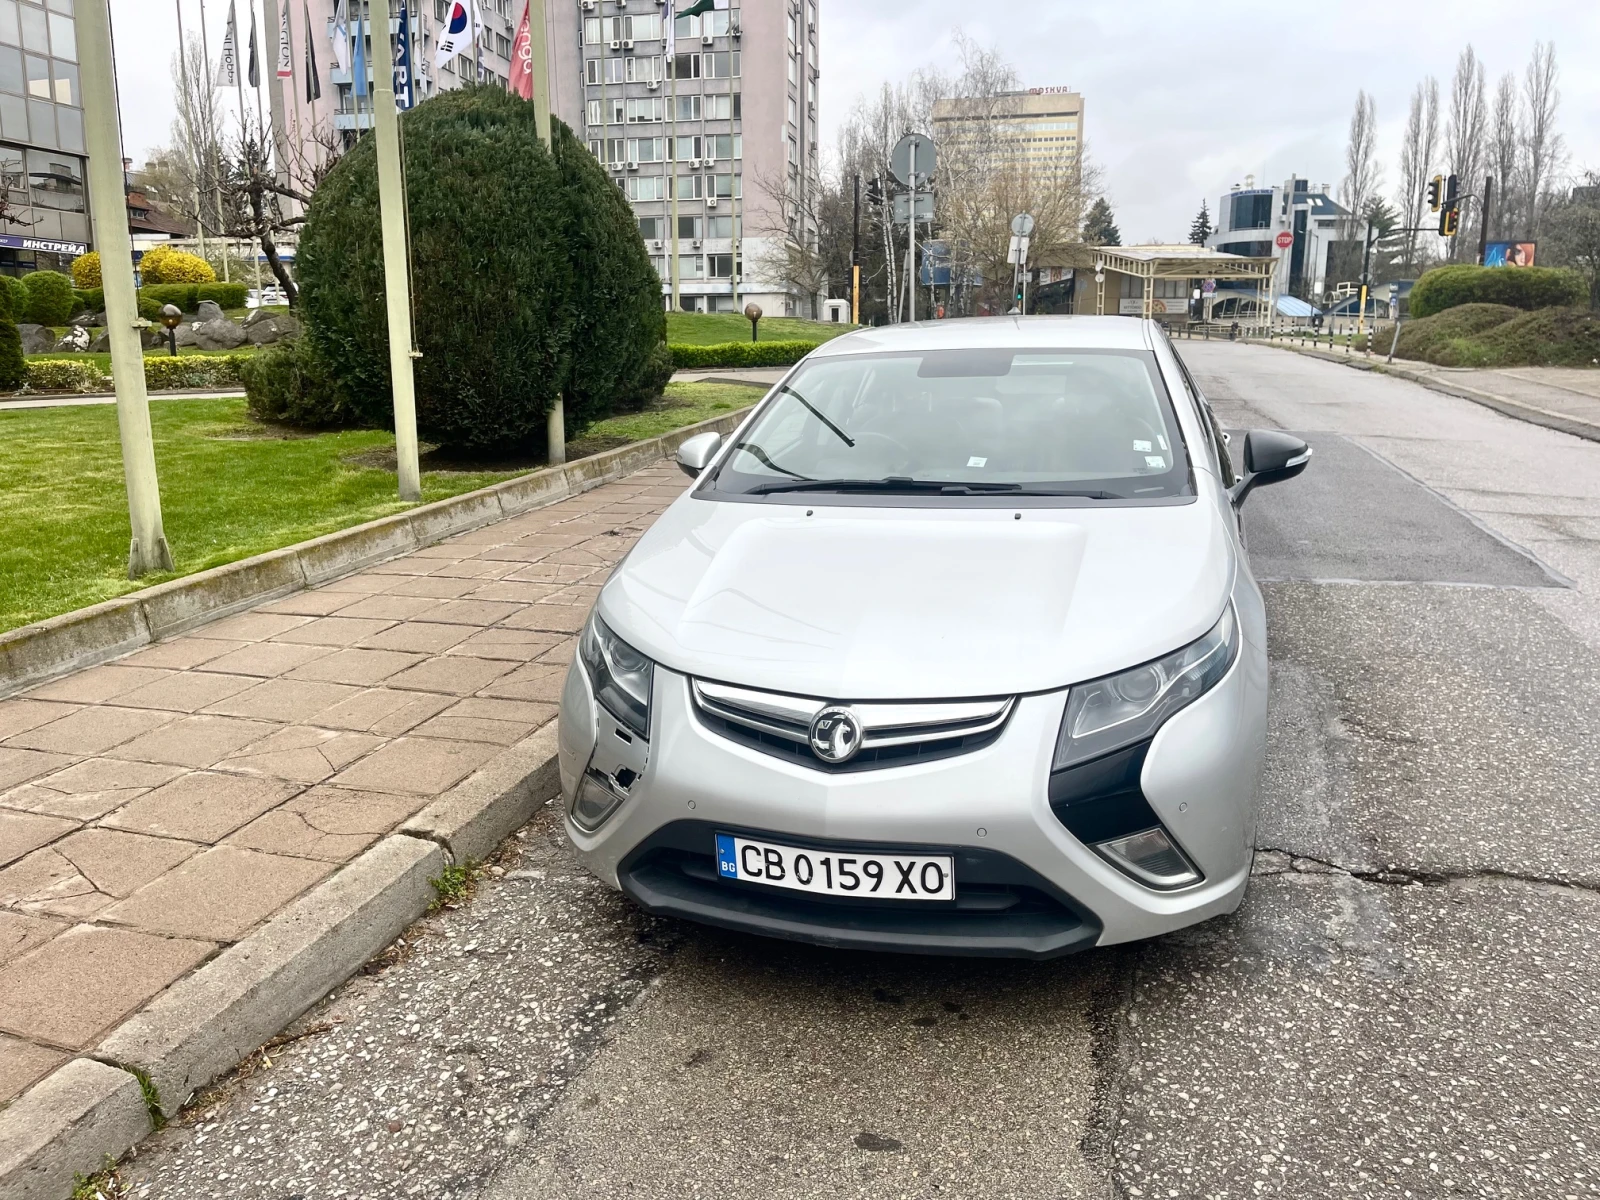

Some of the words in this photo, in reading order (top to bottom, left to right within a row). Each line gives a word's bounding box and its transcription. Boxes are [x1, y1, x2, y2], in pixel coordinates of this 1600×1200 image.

[224, 48, 235, 84] Hobbs
[23, 239, 85, 254] ИНСТРЕЙД
[1277, 236, 1292, 244] STOP
[721, 860, 736, 873] BG
[740, 844, 786, 881] CB
[793, 852, 884, 893] 0159
[893, 860, 945, 894] XO
